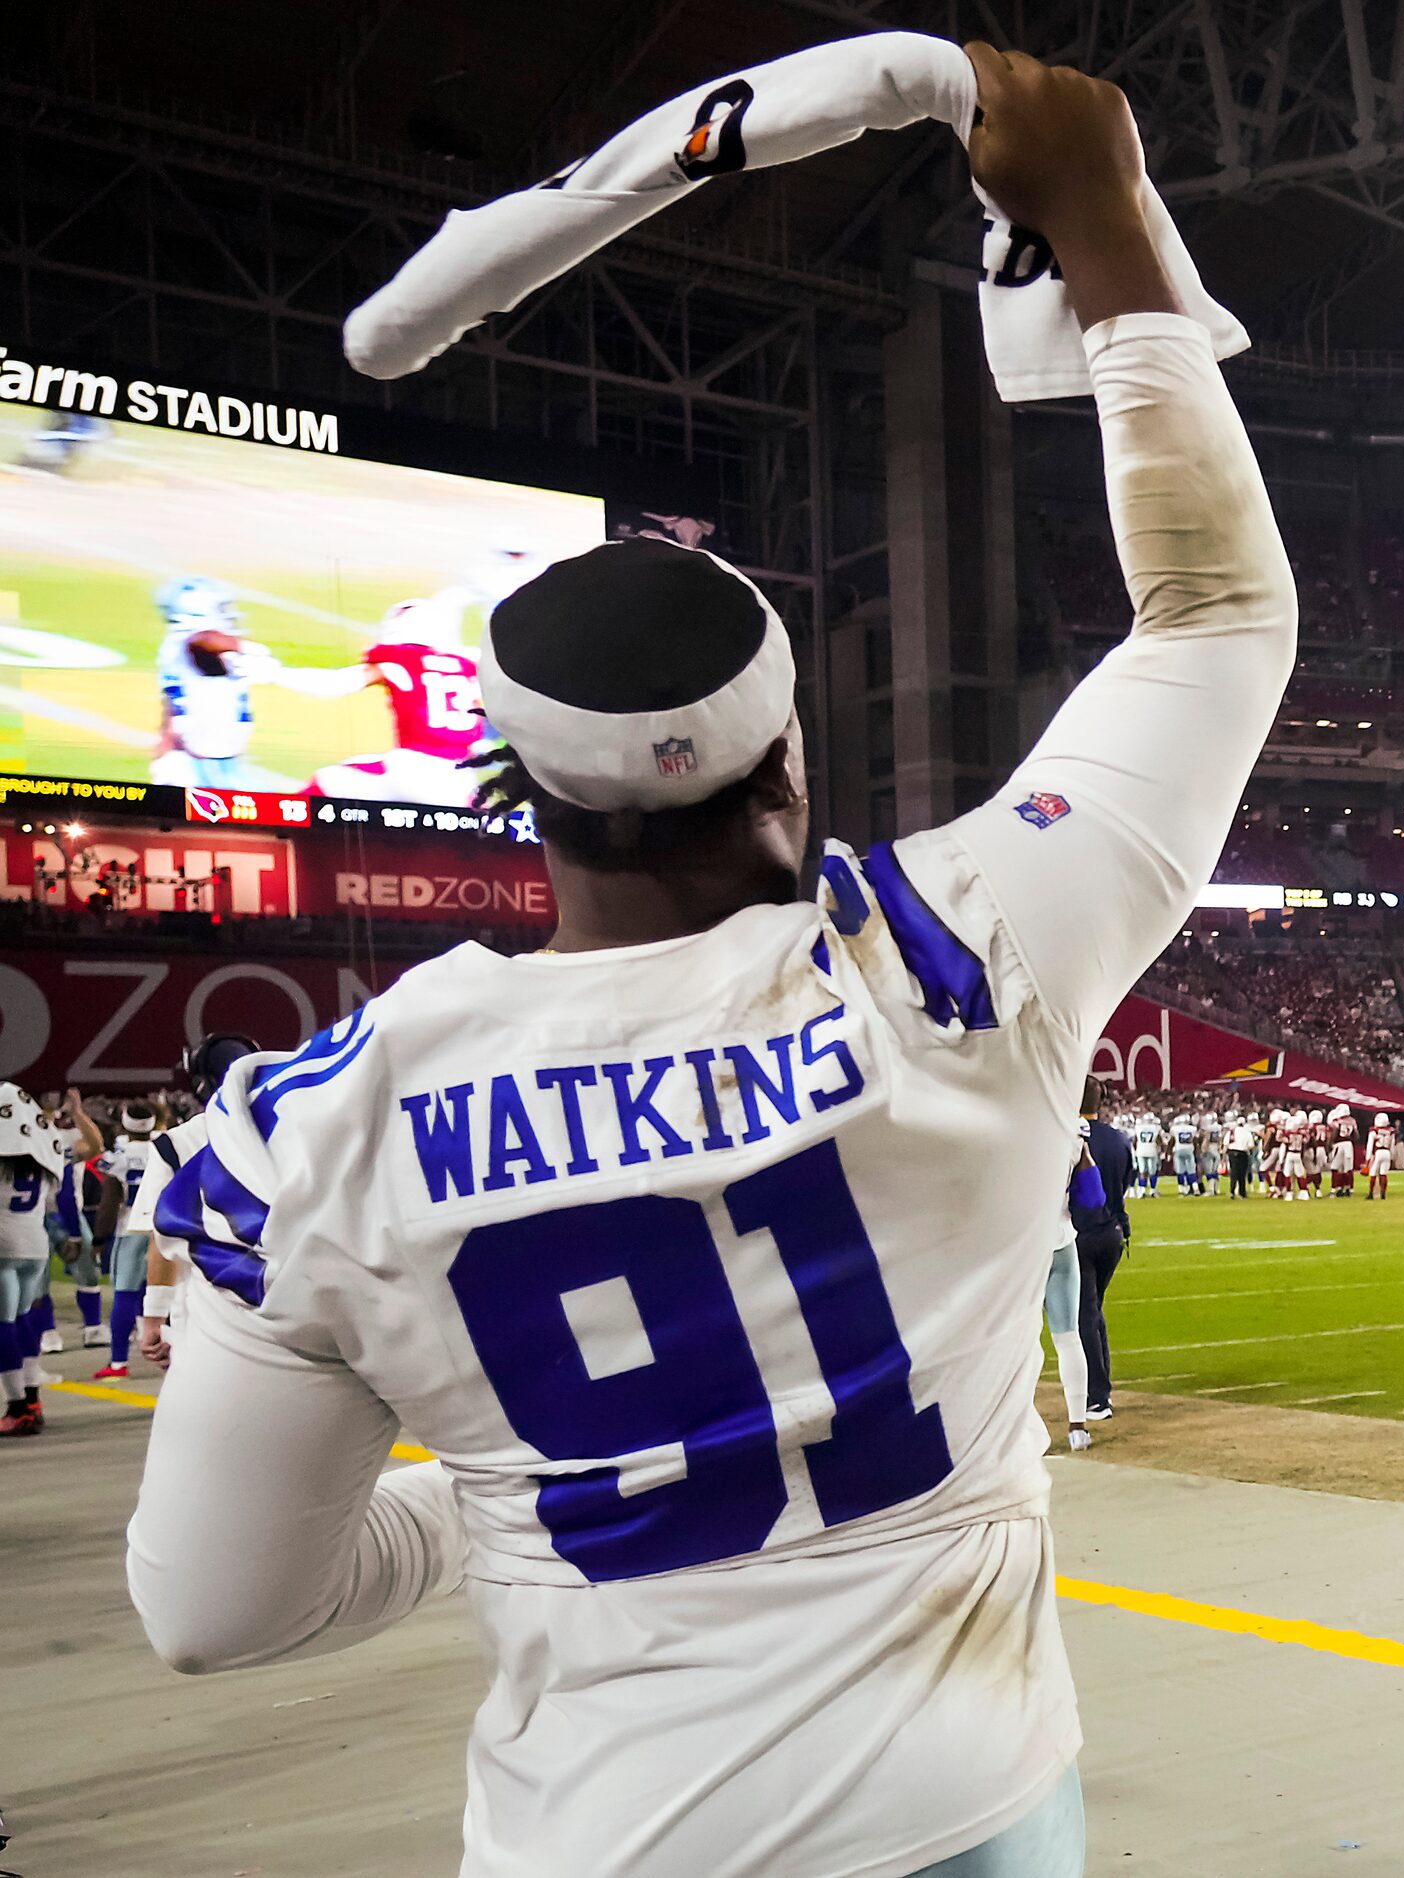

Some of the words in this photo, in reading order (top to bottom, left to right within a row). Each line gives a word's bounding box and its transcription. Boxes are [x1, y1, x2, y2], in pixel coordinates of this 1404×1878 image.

[126, 380, 339, 454] STADIUM
[71, 782, 93, 798] TO
[93, 784, 126, 800] YOU
[317, 803, 336, 824] 4
[335, 871, 548, 914] REDZONE
[400, 1002, 866, 1204] WATKINS
[446, 1136, 956, 1584] 91
